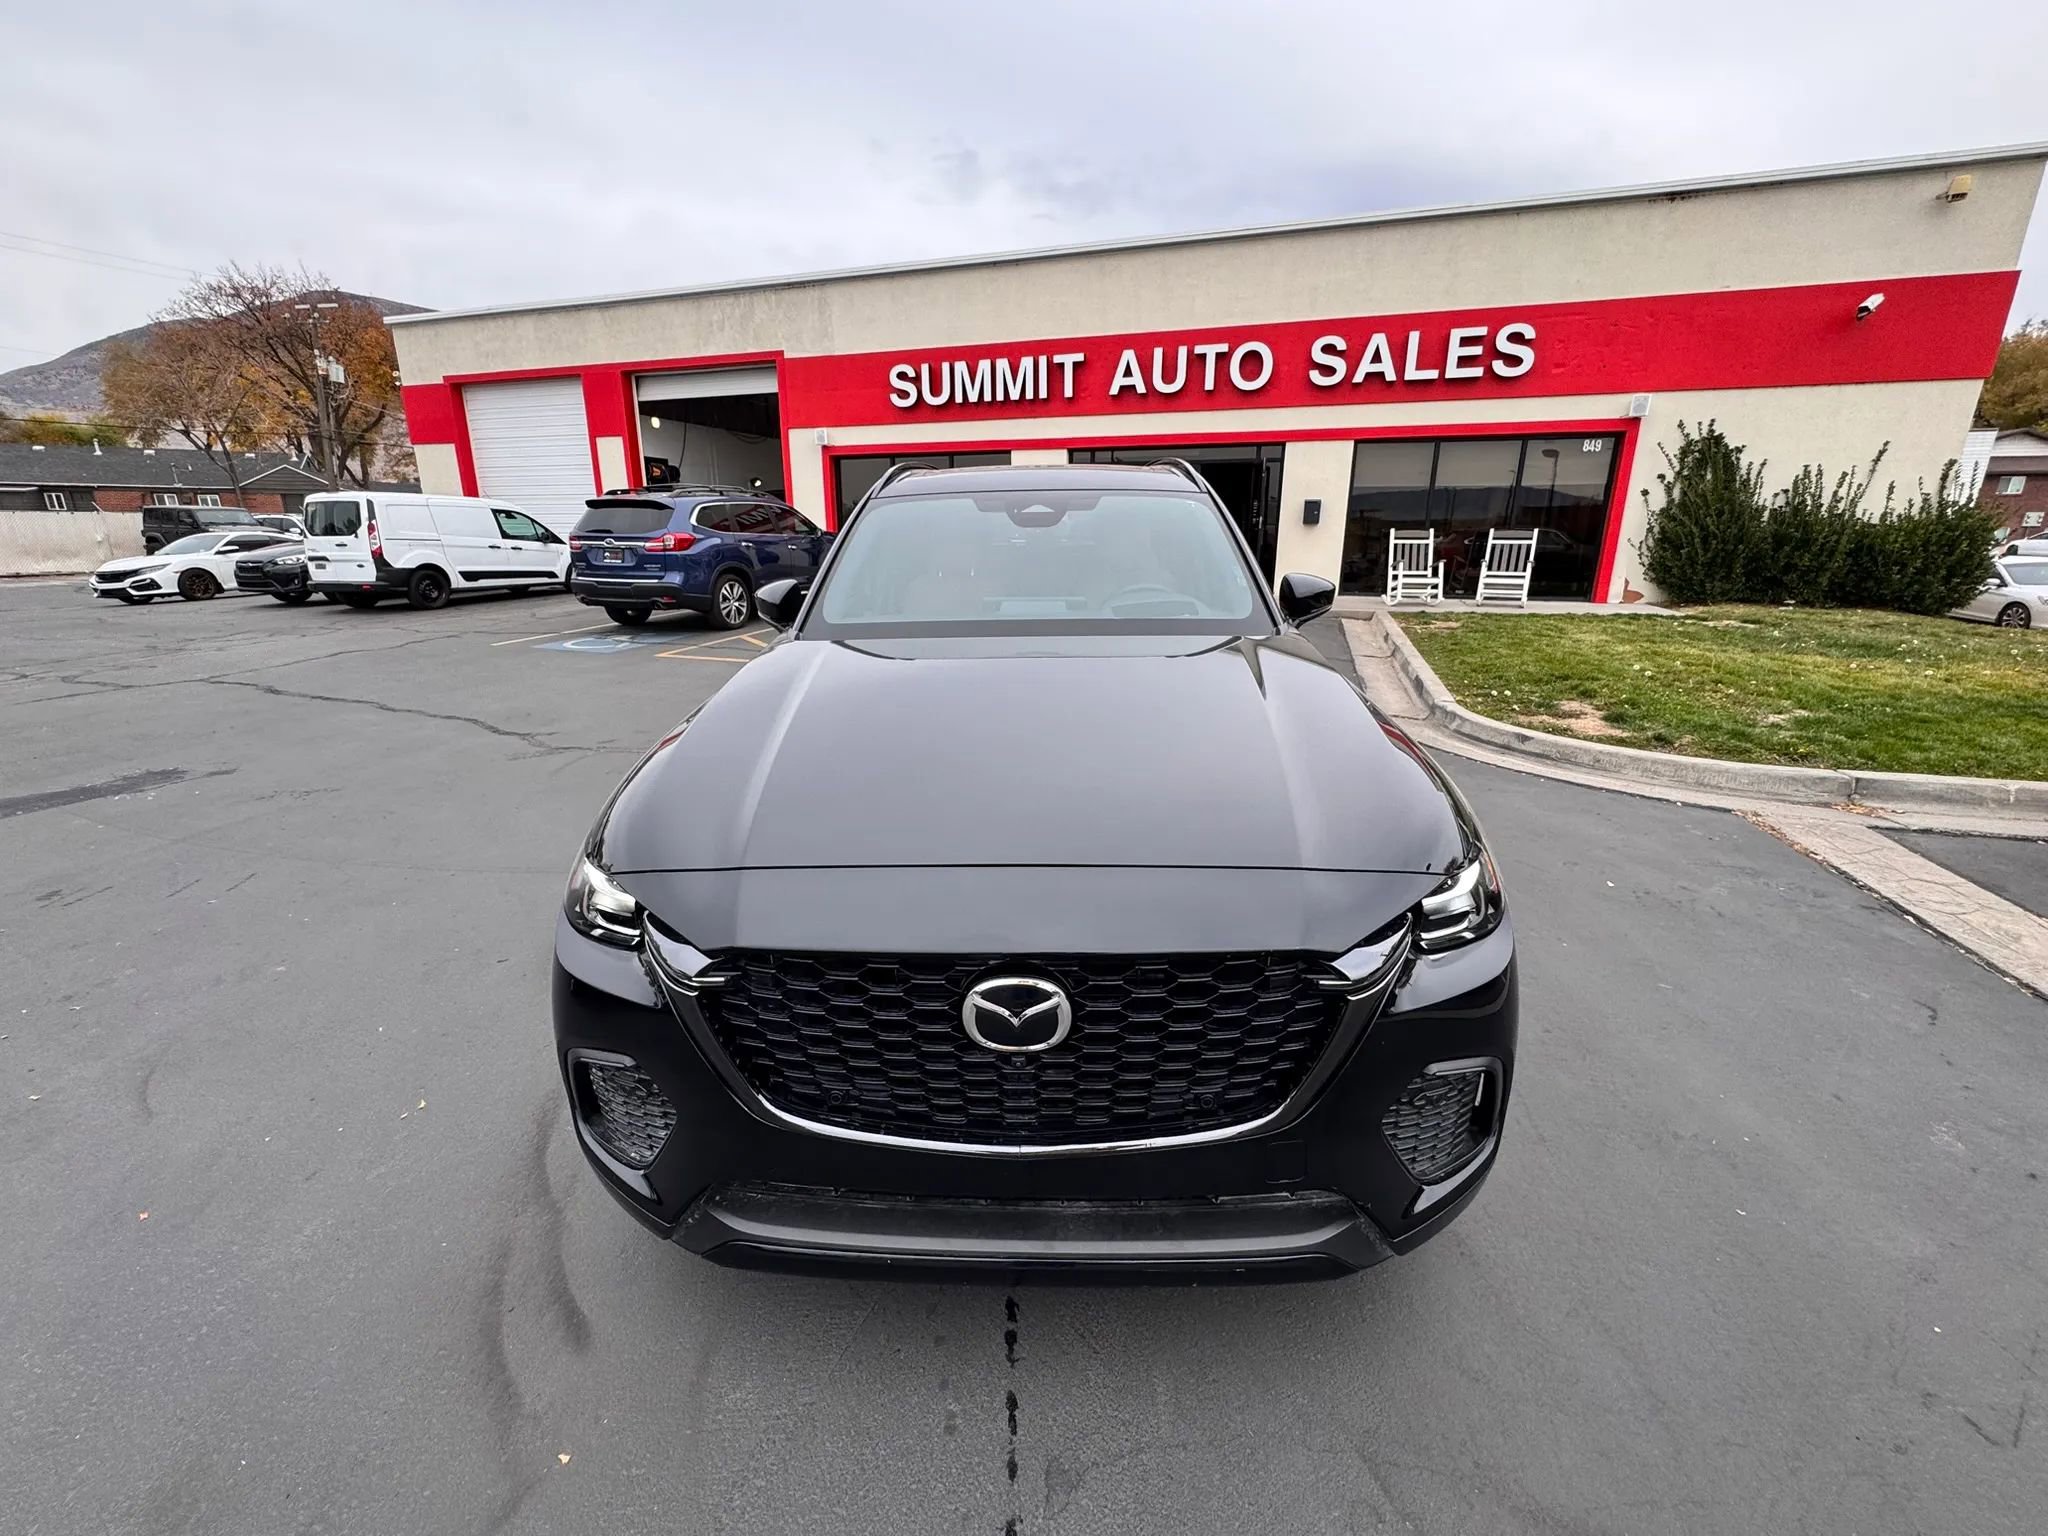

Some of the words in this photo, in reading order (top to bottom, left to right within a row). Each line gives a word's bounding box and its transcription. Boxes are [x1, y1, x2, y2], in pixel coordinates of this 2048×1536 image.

[889, 352, 1085, 408] SUMMIT
[1108, 341, 1274, 396] AUTO
[1308, 322, 1537, 387] SALES
[1583, 439, 1602, 452] 849
